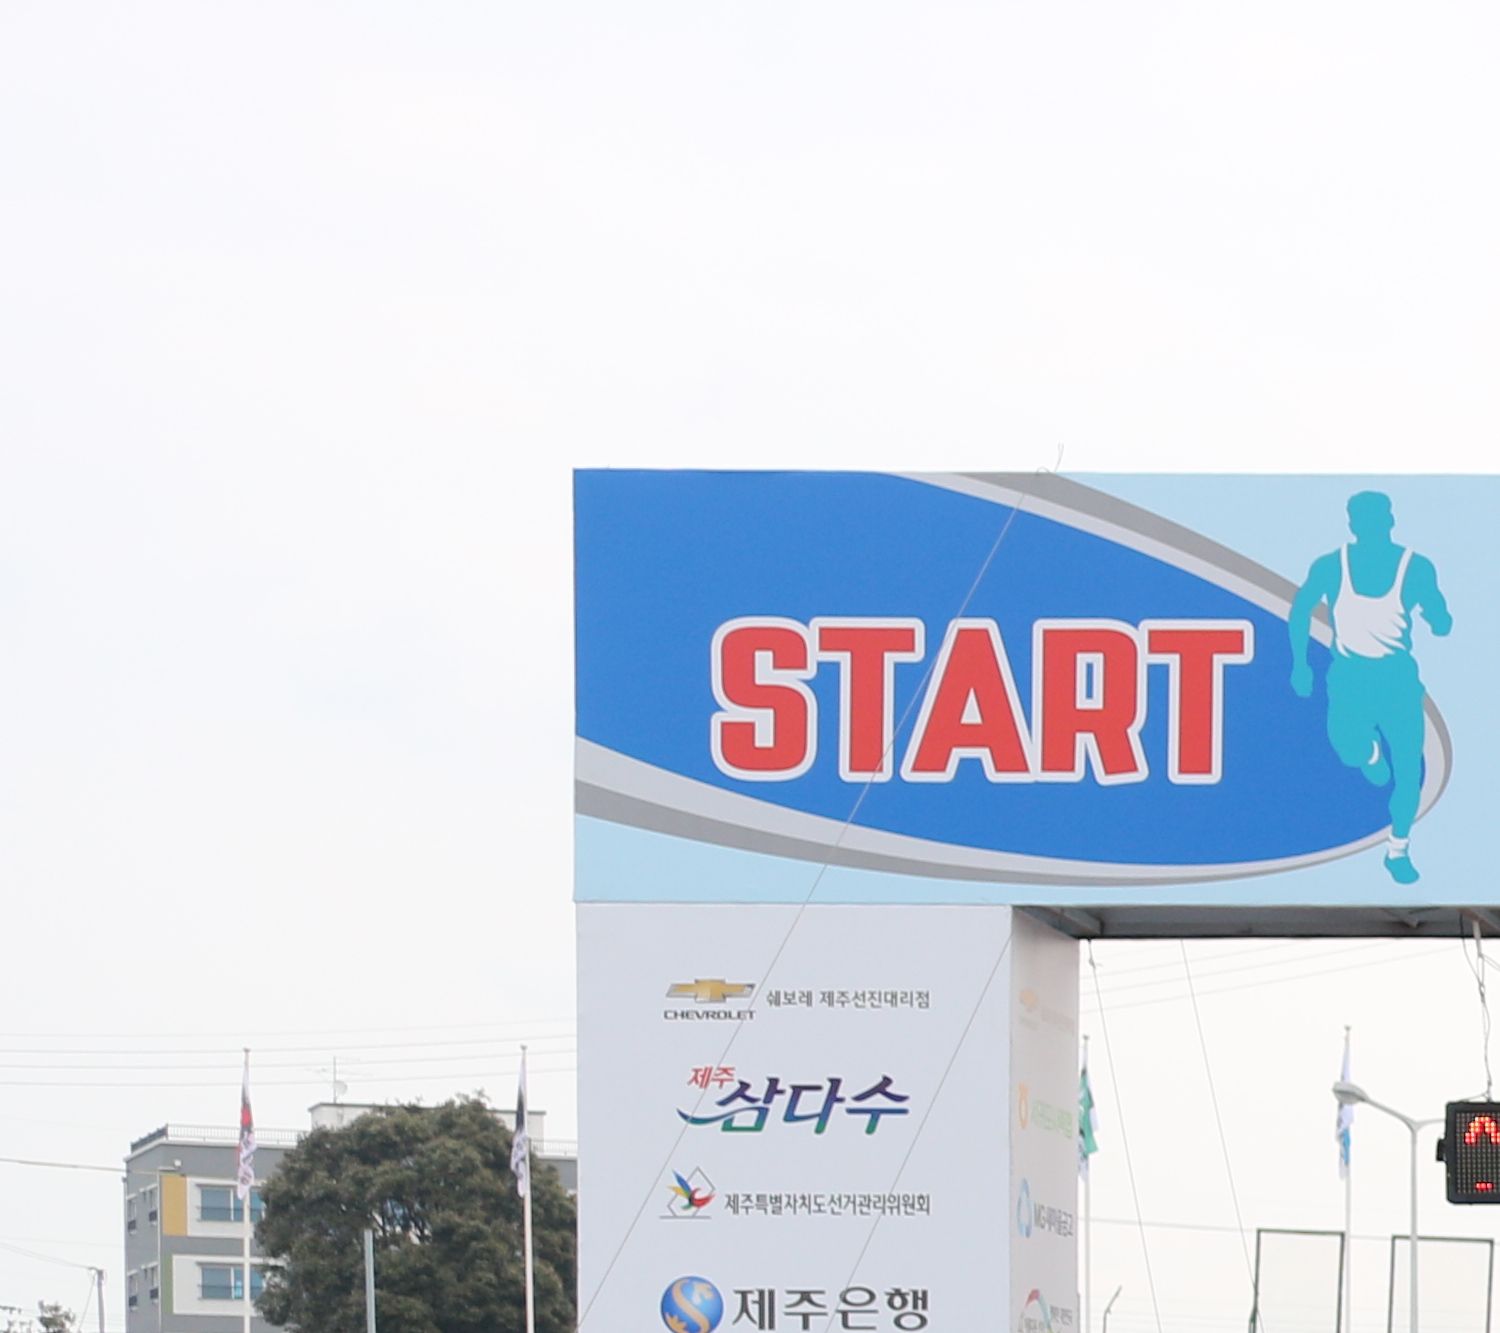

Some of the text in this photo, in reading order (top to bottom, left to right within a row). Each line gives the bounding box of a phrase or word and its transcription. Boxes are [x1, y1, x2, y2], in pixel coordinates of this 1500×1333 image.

[711, 616, 1255, 786] START
[766, 989, 932, 1010] 쉐보레 제주선진대리점
[662, 1008, 757, 1021] CHEVROLET
[686, 1065, 737, 1090] 제주
[677, 1073, 911, 1136] 삼다수
[723, 1192, 932, 1217] 제주특별자치도선거관리위원회
[731, 1286, 931, 1333] 제주은행
